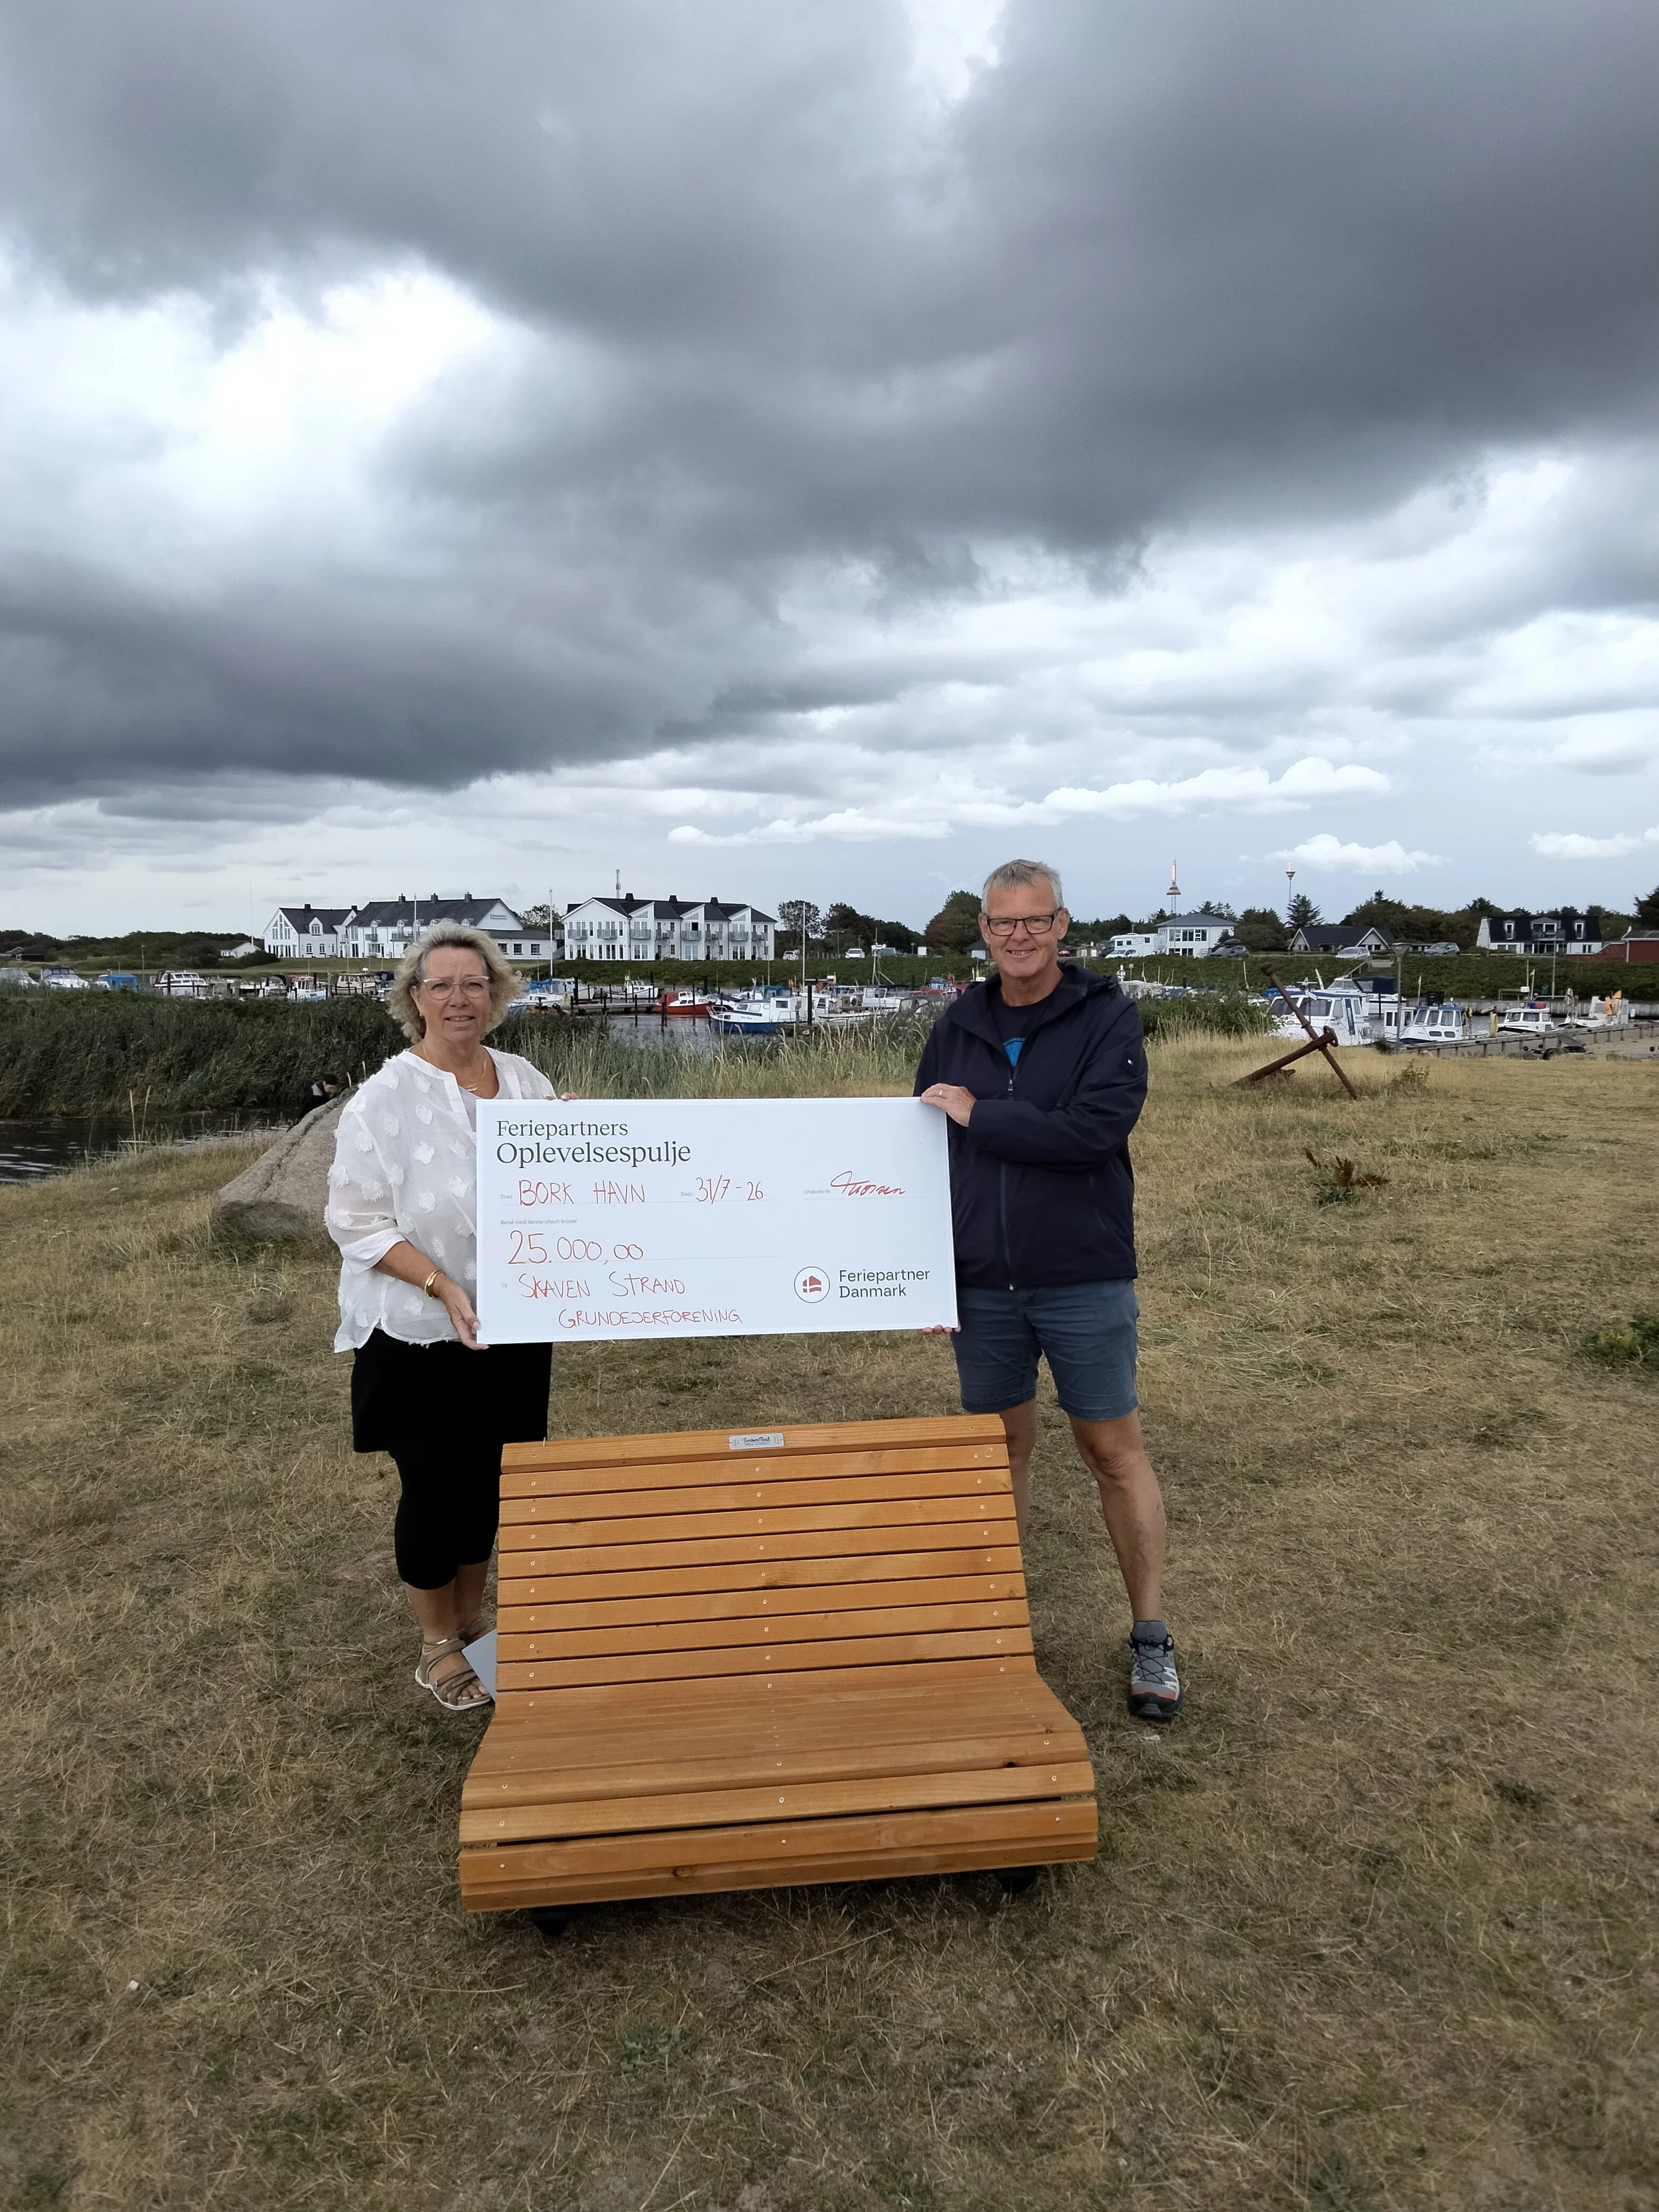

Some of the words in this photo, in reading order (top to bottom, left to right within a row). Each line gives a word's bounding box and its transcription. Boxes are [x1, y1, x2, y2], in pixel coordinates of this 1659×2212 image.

[496, 1120, 628, 1140] Feriepartners
[496, 1141, 691, 1169] Oplevelsespulje
[518, 1179, 574, 1206] BORK
[593, 1180, 646, 1205] HAVN
[518, 1273, 591, 1299] SKAVEN
[609, 1271, 685, 1297] STRAND
[839, 1269, 930, 1285] Feriepartner
[839, 1284, 906, 1298] Danmark
